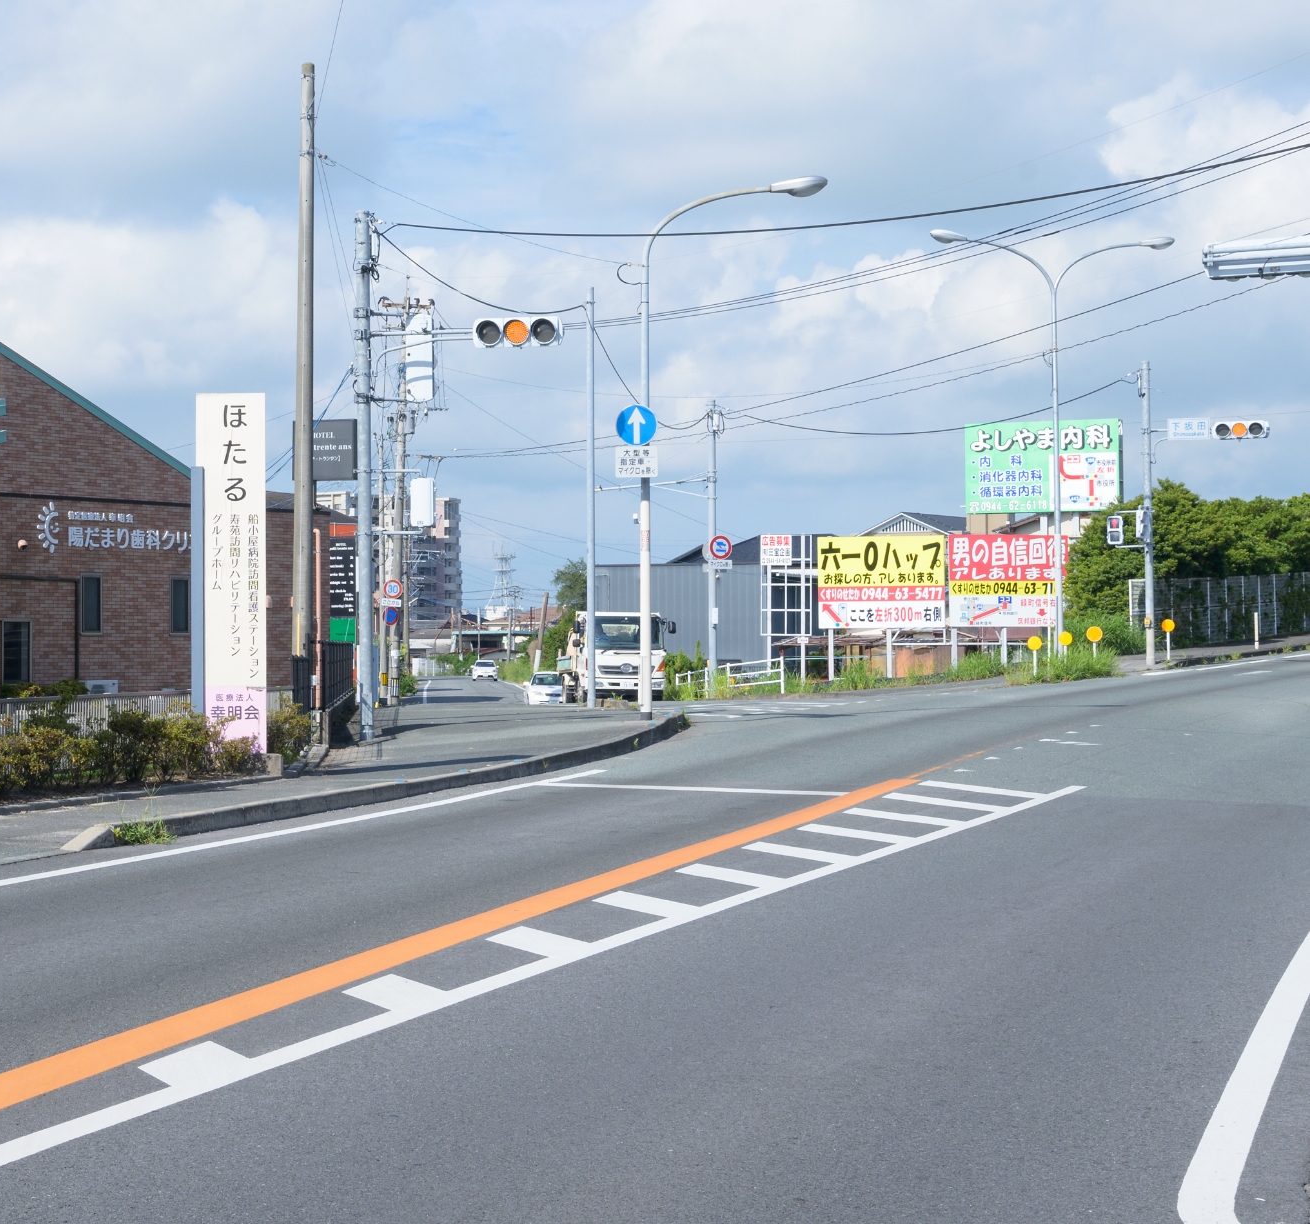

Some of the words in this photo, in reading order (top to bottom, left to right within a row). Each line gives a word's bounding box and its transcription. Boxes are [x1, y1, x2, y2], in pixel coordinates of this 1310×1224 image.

[1172, 421, 1206, 431] 下坂田
[970, 424, 1113, 451] よしやま内科
[223, 404, 247, 502] ほたる
[623, 449, 650, 457] 大型等
[618, 467, 656, 475] マイクロを除く
[981, 500, 1047, 511] 0944-62-6118
[68, 526, 191, 551] 陽だまり歯科クリ
[761, 536, 790, 547] 広告募集
[211, 513, 222, 590] グループホーム
[229, 513, 241, 657] 寿苑訪問リハビリテーション
[387, 584, 398, 594] 30
[952, 583, 991, 594] くすりのせたか
[993, 582, 1055, 594] 0944-63-71
[247, 513, 259, 678] 船小屋病院訪問看護ステーション
[819, 588, 860, 600] くすりのせたか
[861, 587, 943, 600] 0944-63-5477
[215, 693, 254, 702] 医療法人
[210, 705, 259, 720] 幸明会
